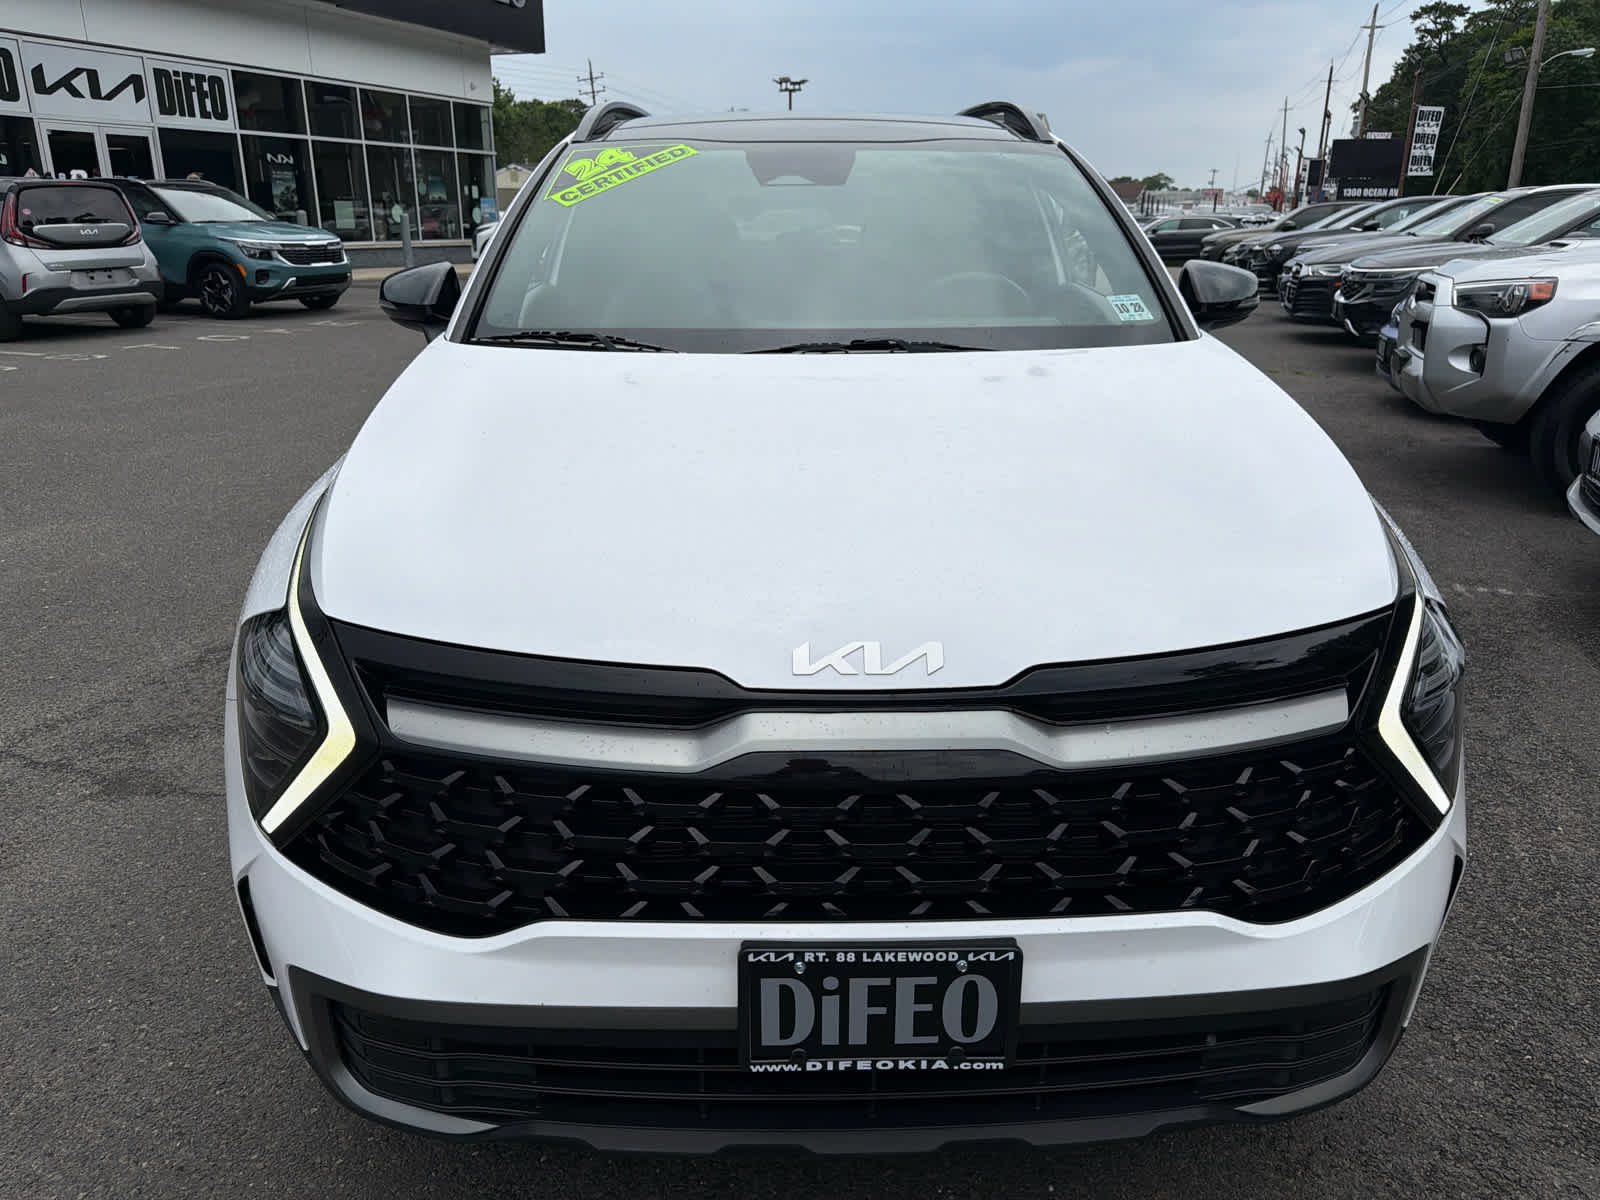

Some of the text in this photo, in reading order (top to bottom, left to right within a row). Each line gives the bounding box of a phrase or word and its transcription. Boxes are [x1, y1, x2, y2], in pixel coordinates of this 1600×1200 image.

[31, 63, 145, 104] KIA
[153, 67, 229, 121] DiFEO
[559, 148, 687, 202] CERTIFIED
[564, 148, 638, 181] 24
[1343, 187, 1362, 197] 1300
[1363, 187, 1388, 197] OCEAN
[792, 640, 945, 676] KIA
[804, 952, 829, 962] RT.
[836, 952, 856, 962] 88
[862, 951, 959, 962] LAKEWOOD
[760, 974, 998, 1046] DiFEO
[750, 1060, 1004, 1073] www.DIFEOKIA.com
